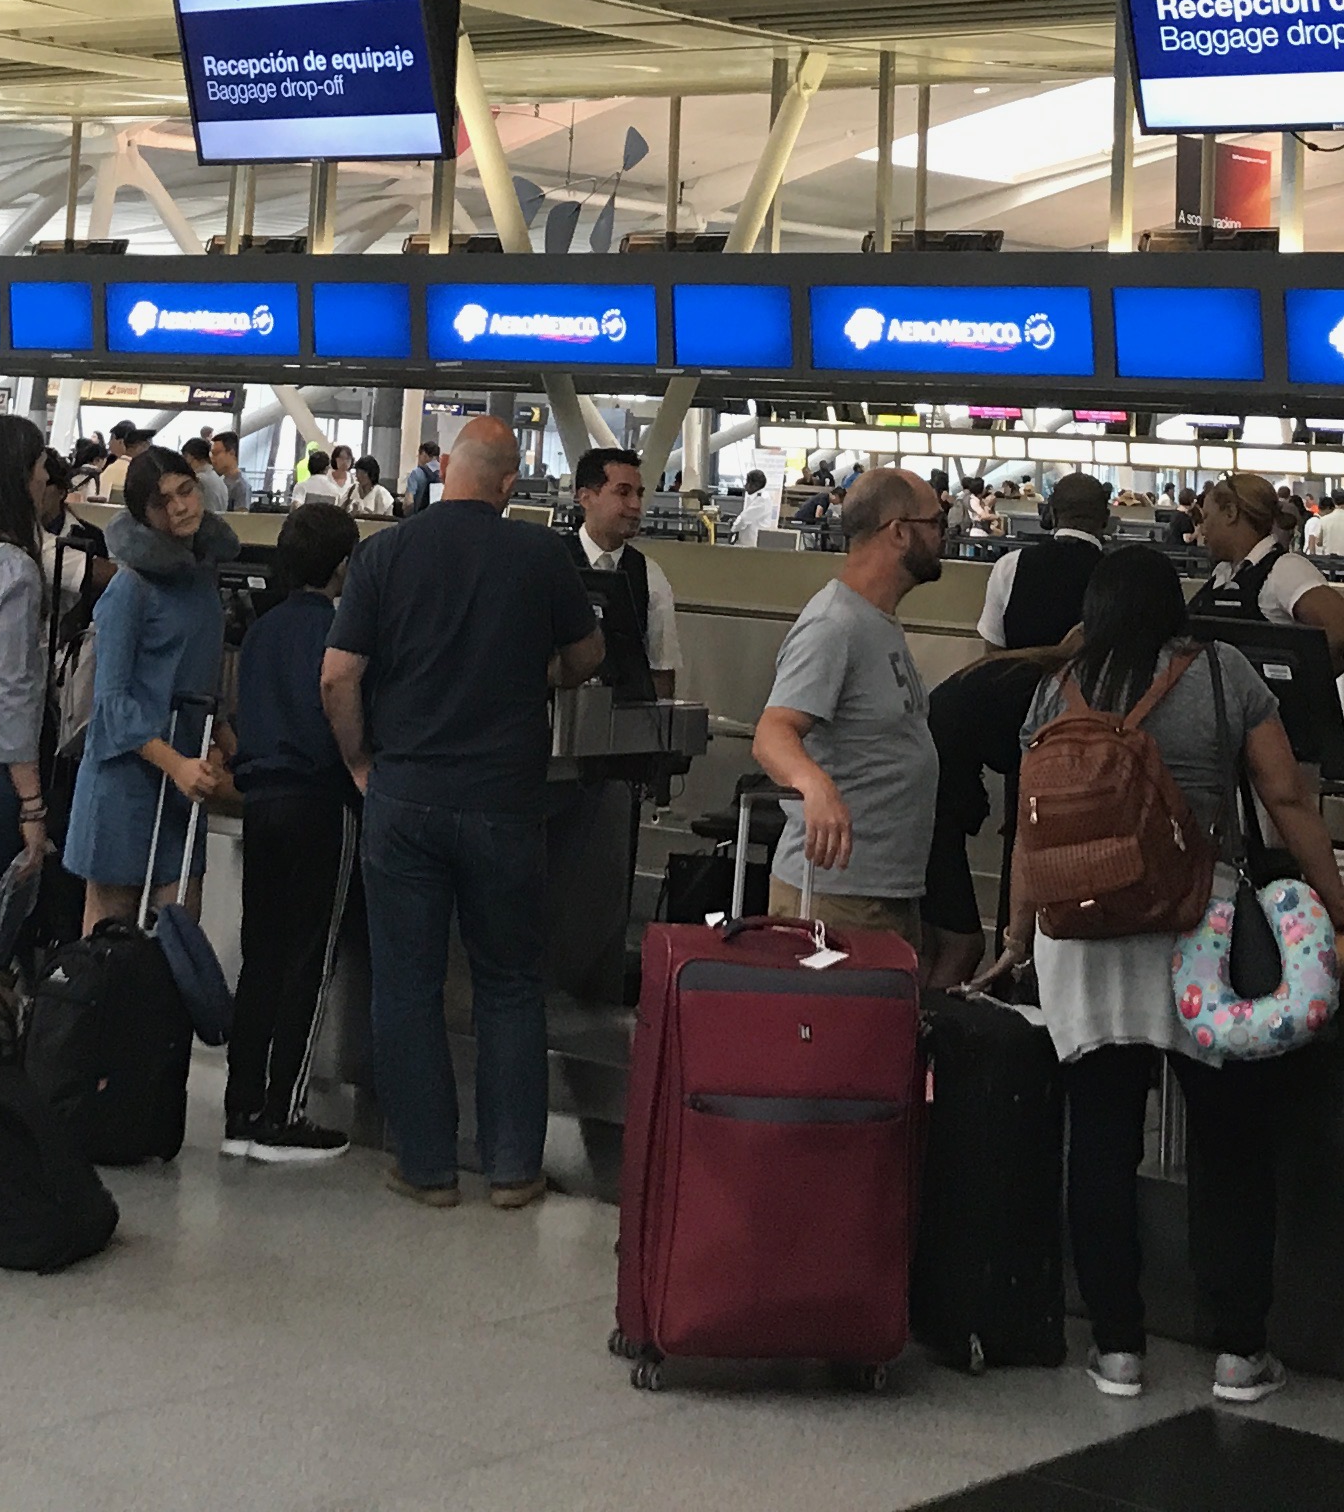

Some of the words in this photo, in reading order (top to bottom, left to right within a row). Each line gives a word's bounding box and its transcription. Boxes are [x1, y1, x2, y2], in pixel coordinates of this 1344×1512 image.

[1159, 23, 1279, 57] Baggage
[203, 50, 299, 79] Recepción
[303, 50, 327, 72] de
[331, 45, 414, 73] equipaje
[207, 80, 277, 104] Baggage
[280, 74, 344, 101] drop-off
[887, 318, 1021, 344] AEROMEXICO
